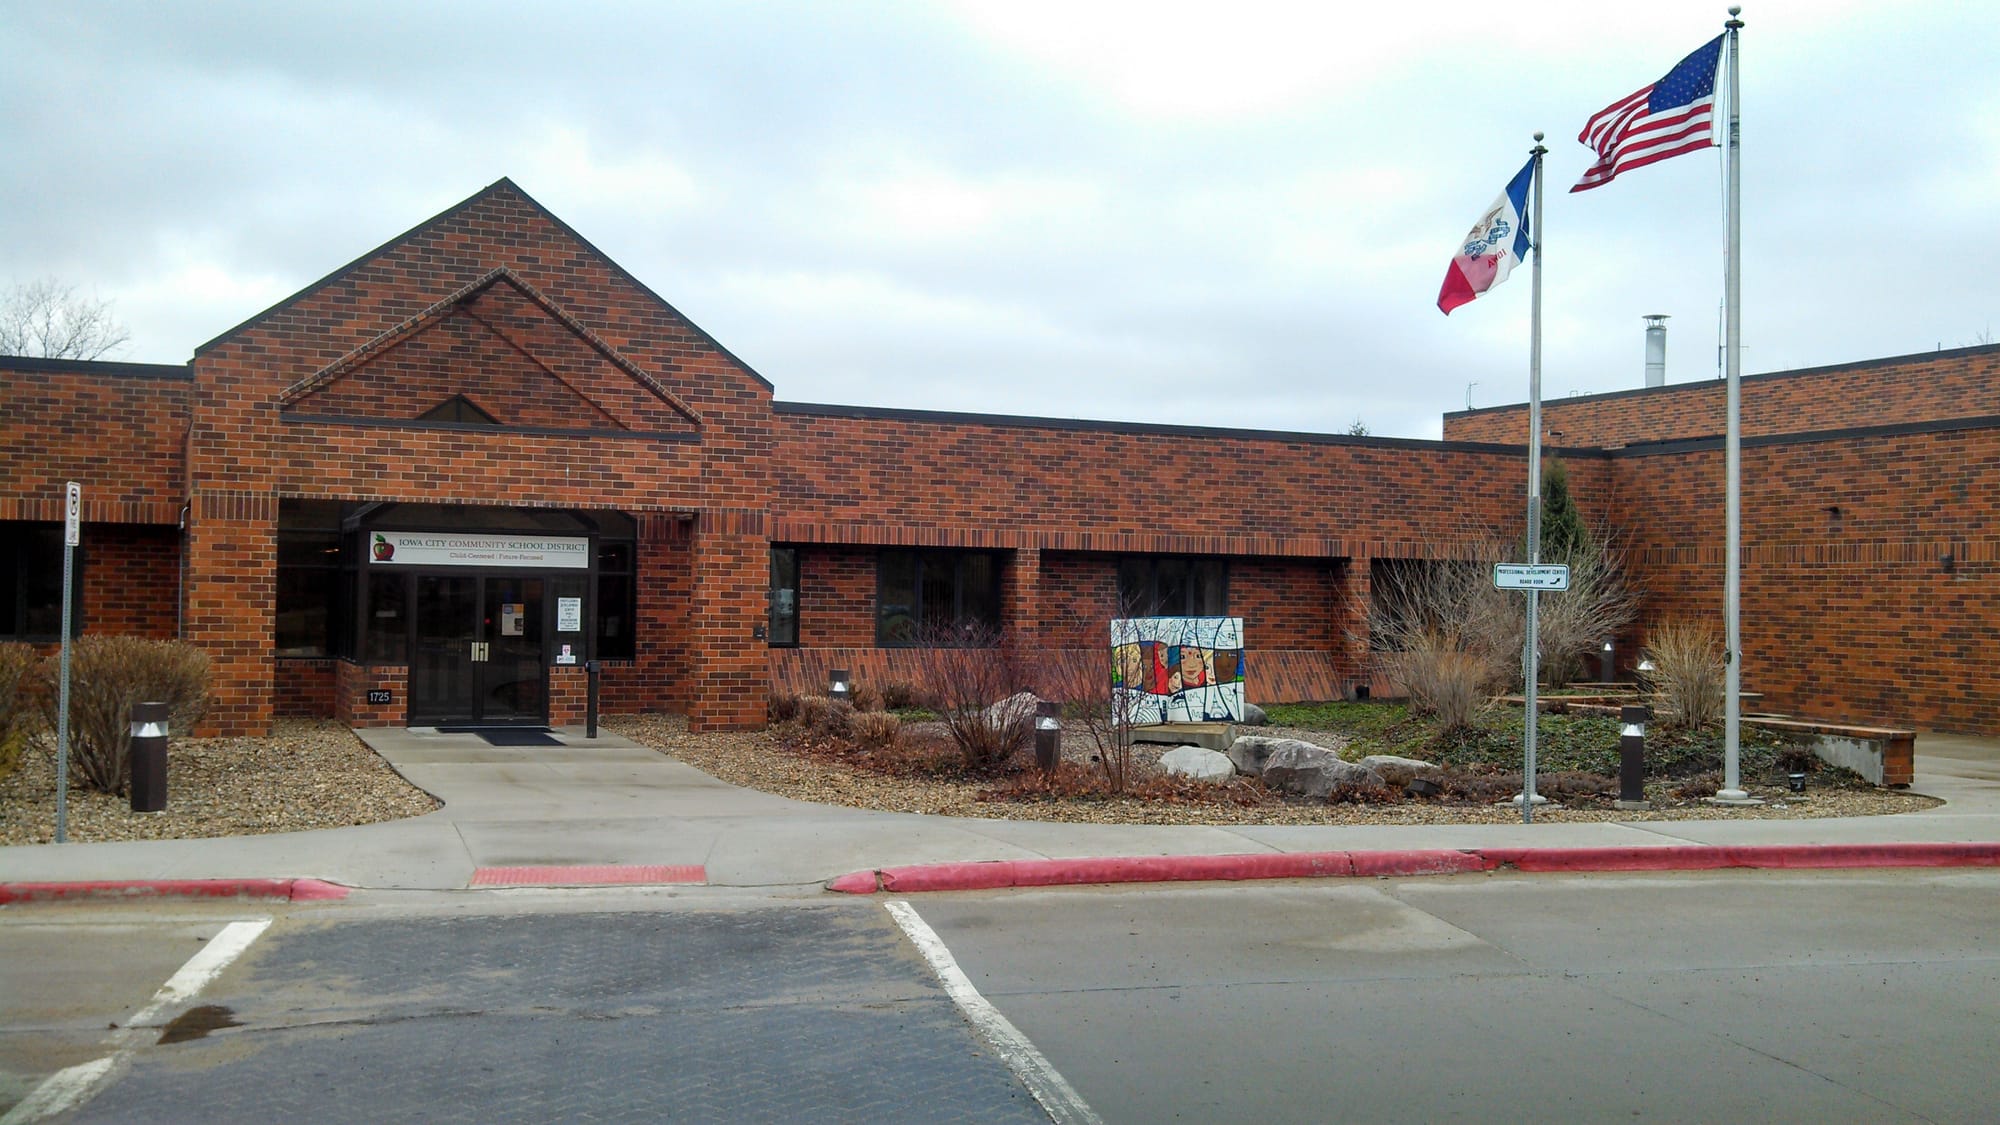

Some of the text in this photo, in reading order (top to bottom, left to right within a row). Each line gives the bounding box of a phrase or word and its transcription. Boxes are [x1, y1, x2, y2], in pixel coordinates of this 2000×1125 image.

[399, 538, 586, 552] IOWA CITY COMMUNITY SCHOOL DISTRICT
[370, 692, 390, 701] 1725
